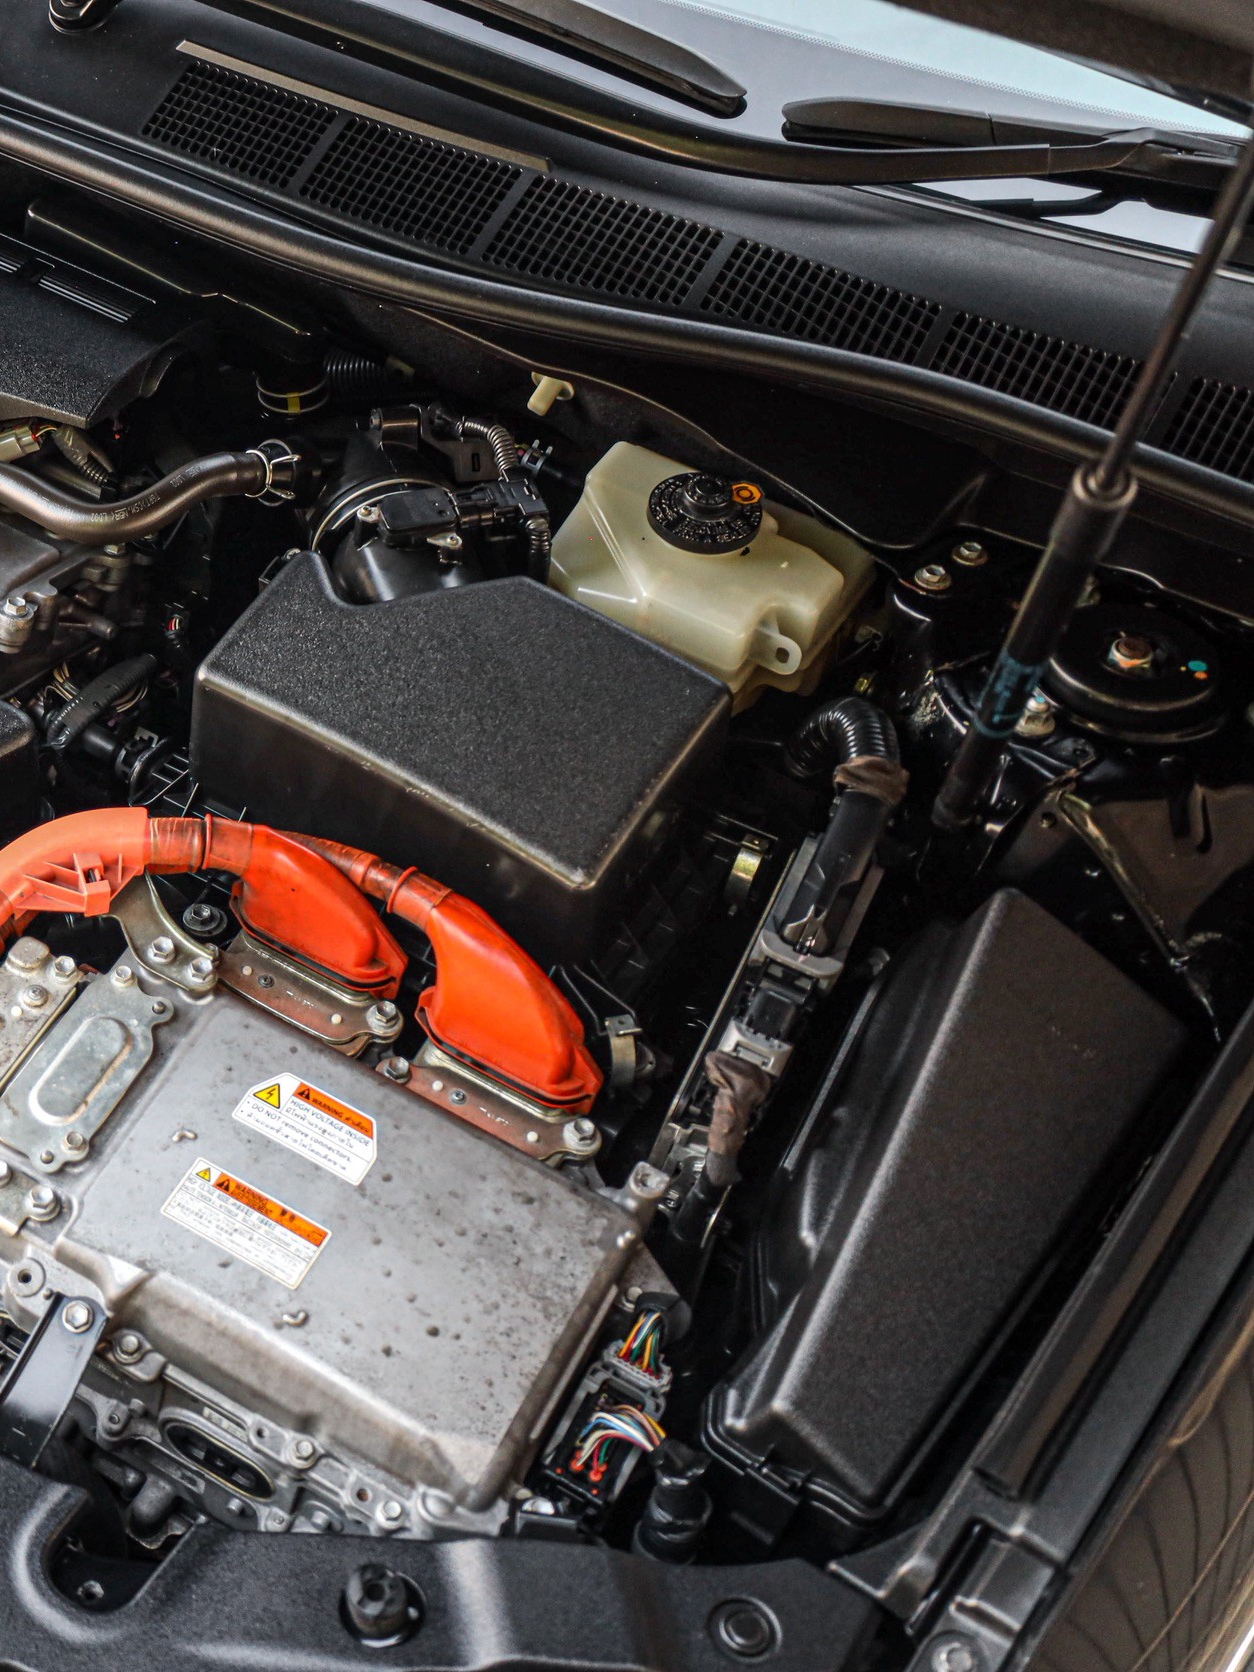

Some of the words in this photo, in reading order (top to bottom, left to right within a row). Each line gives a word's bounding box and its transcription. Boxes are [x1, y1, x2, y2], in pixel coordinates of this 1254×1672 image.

[250, 1102, 265, 1113] DO
[263, 1109, 282, 1122] NOT
[280, 1118, 310, 1139] remove
[289, 1098, 312, 1114] HIGH
[309, 1109, 345, 1132] VOLTAGE
[343, 1128, 371, 1147] INSIDE
[310, 1096, 344, 1119] WARNING
